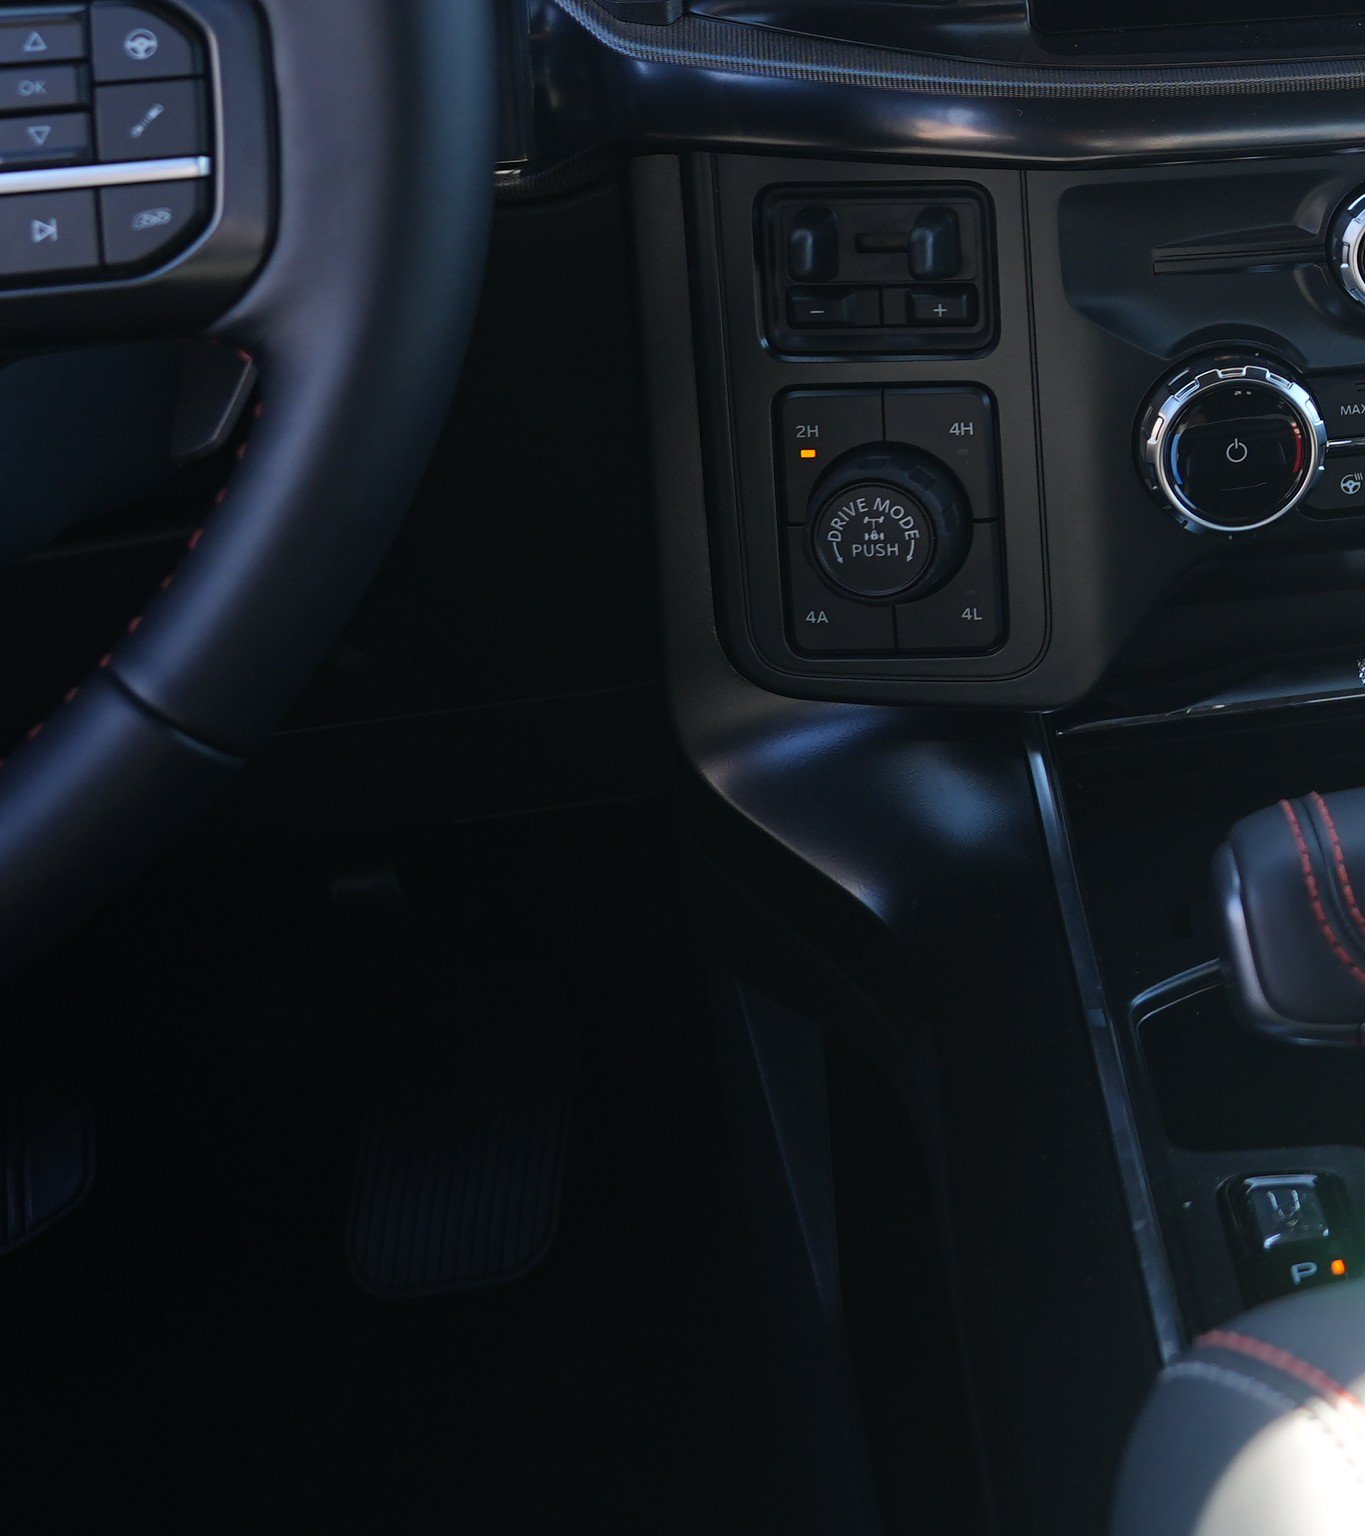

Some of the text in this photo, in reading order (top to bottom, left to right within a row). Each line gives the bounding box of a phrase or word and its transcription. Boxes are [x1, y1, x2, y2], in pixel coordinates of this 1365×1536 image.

[17, 79, 47, 96] OK
[796, 425, 819, 439] 2H
[949, 422, 974, 436] 4H
[827, 497, 919, 543] DRIVE MODE
[852, 543, 899, 557] PUSH
[806, 611, 828, 624] 4A
[961, 608, 982, 621] 4L
[1291, 1262, 1318, 1285] P
